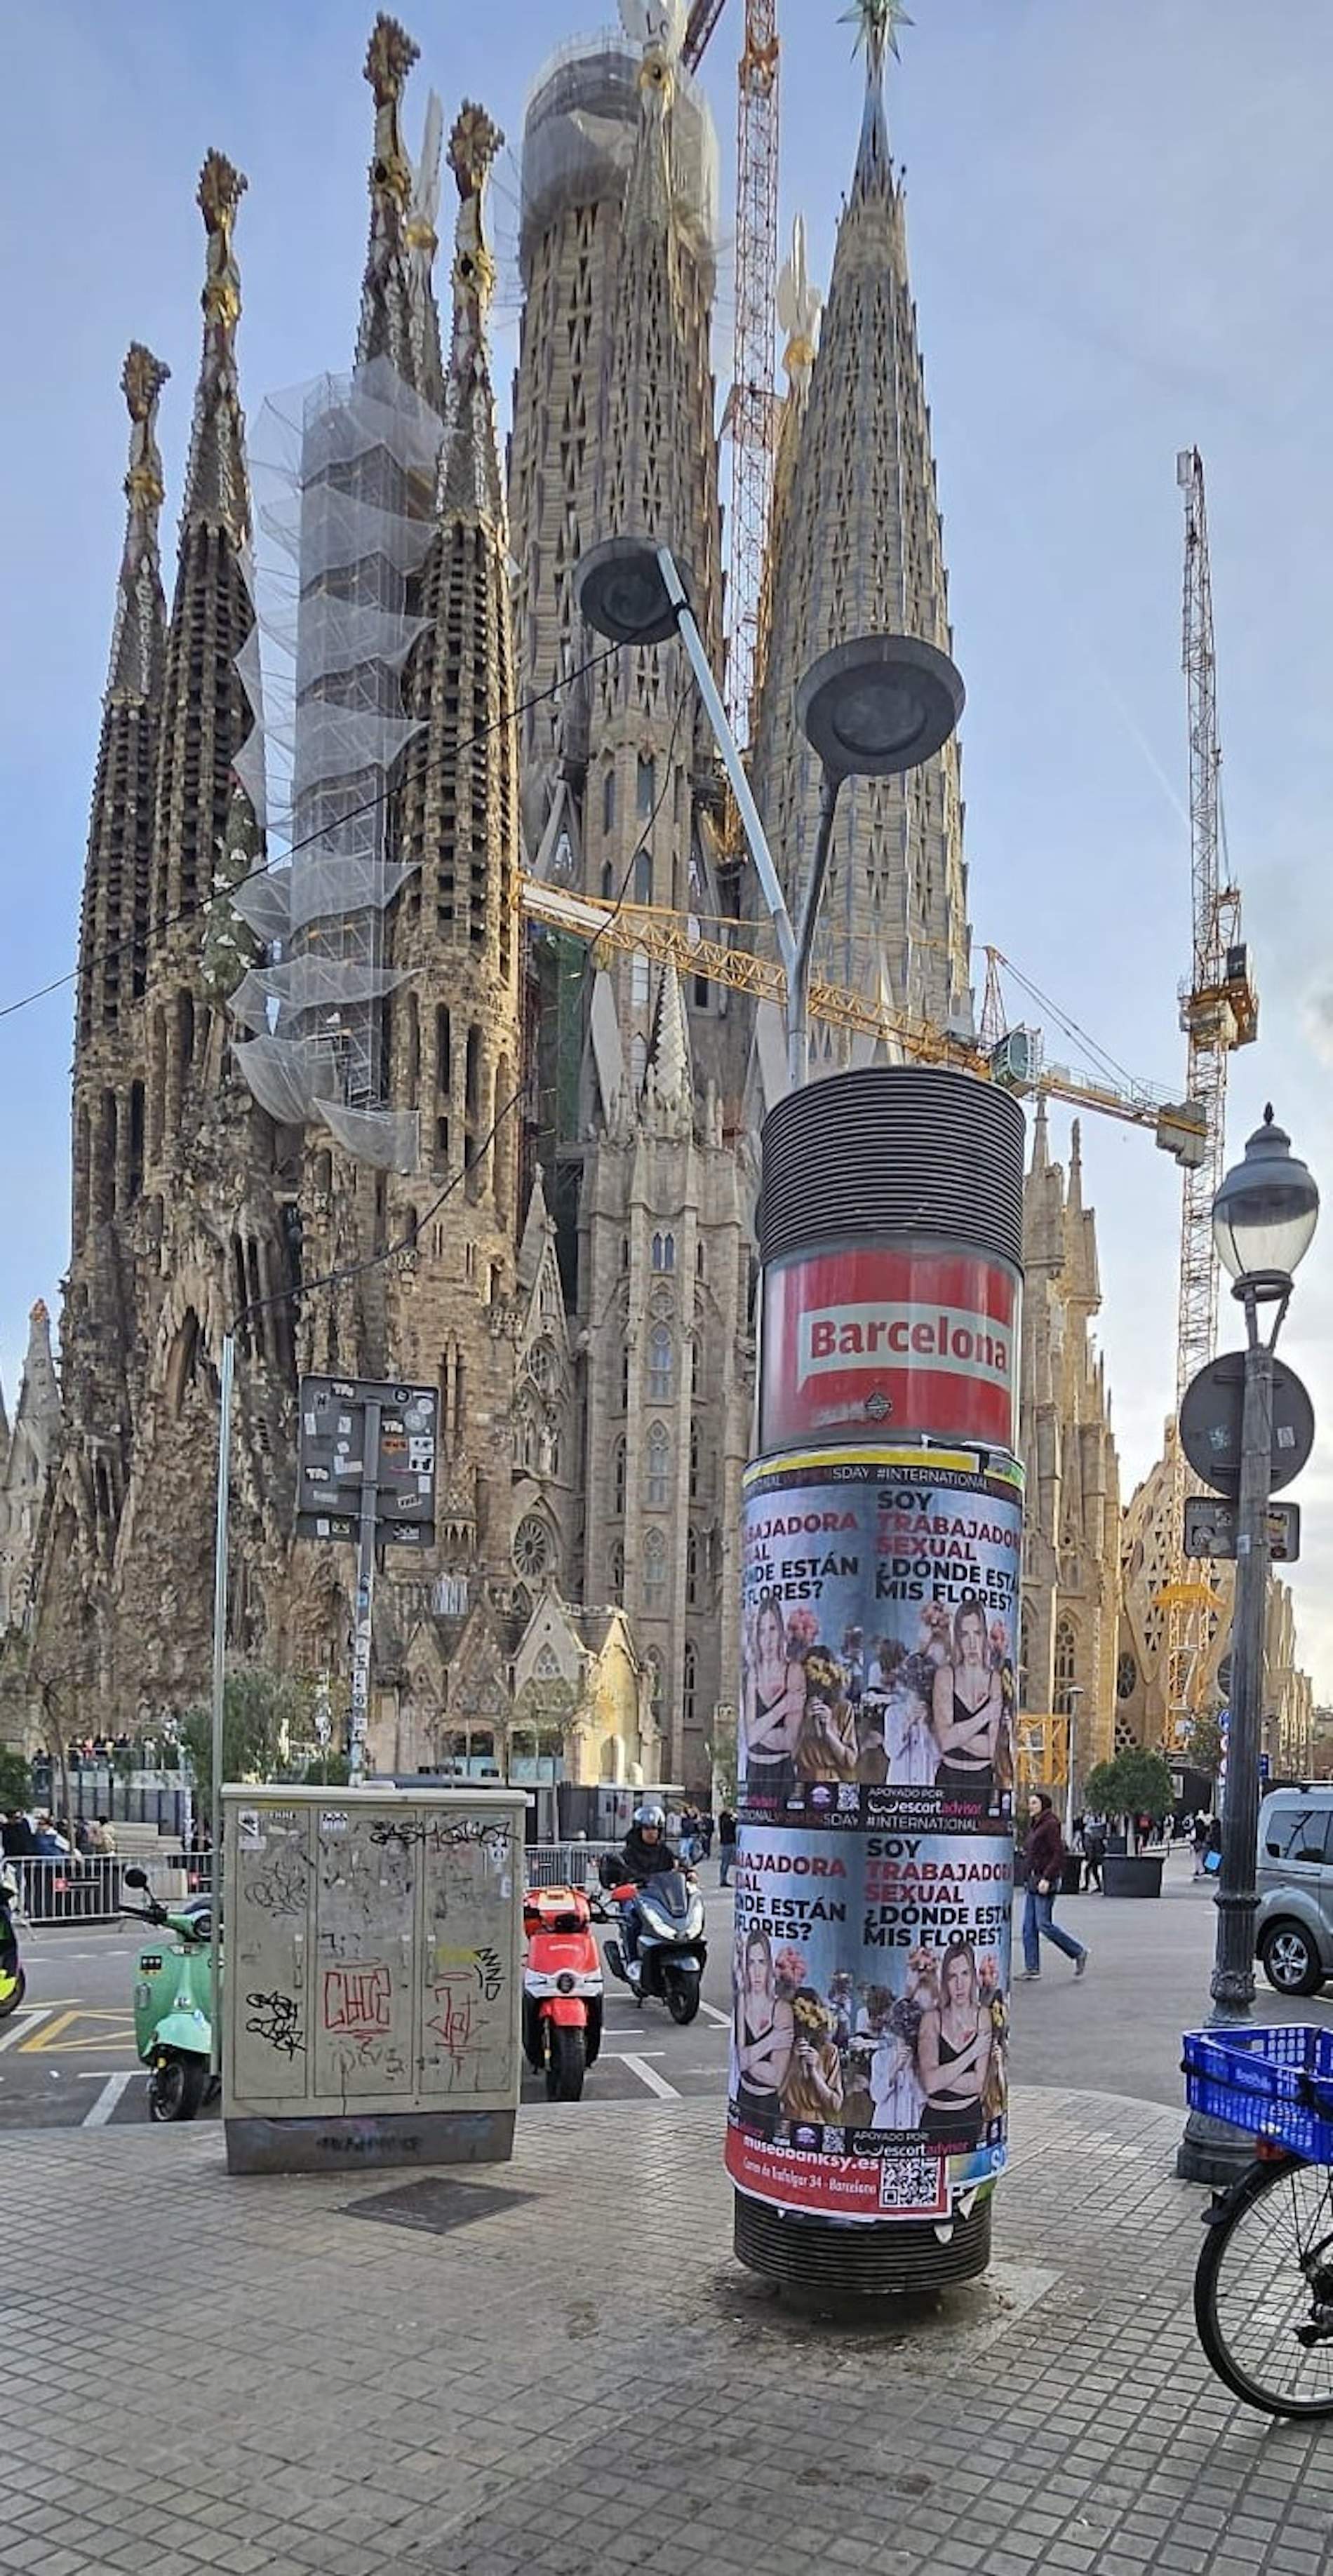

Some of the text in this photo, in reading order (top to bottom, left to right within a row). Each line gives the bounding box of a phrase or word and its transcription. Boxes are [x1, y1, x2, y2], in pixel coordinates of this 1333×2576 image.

[812, 1316, 1007, 1373] Barcelona
[876, 1490, 933, 1511] SOY
[876, 1536, 977, 1561] SEXUAL
[782, 1551, 858, 1579] ESTÁN
[876, 1580, 1012, 1613] MIS FLORES?
[868, 1838, 921, 1858] SOY
[865, 1883, 964, 1904] SEXUAL
[772, 1896, 846, 1921] ESTÁN
[864, 1928, 911, 1947] MIS
[743, 2134, 878, 2173] museobanksy.es
[808, 2174, 822, 2189] 34
